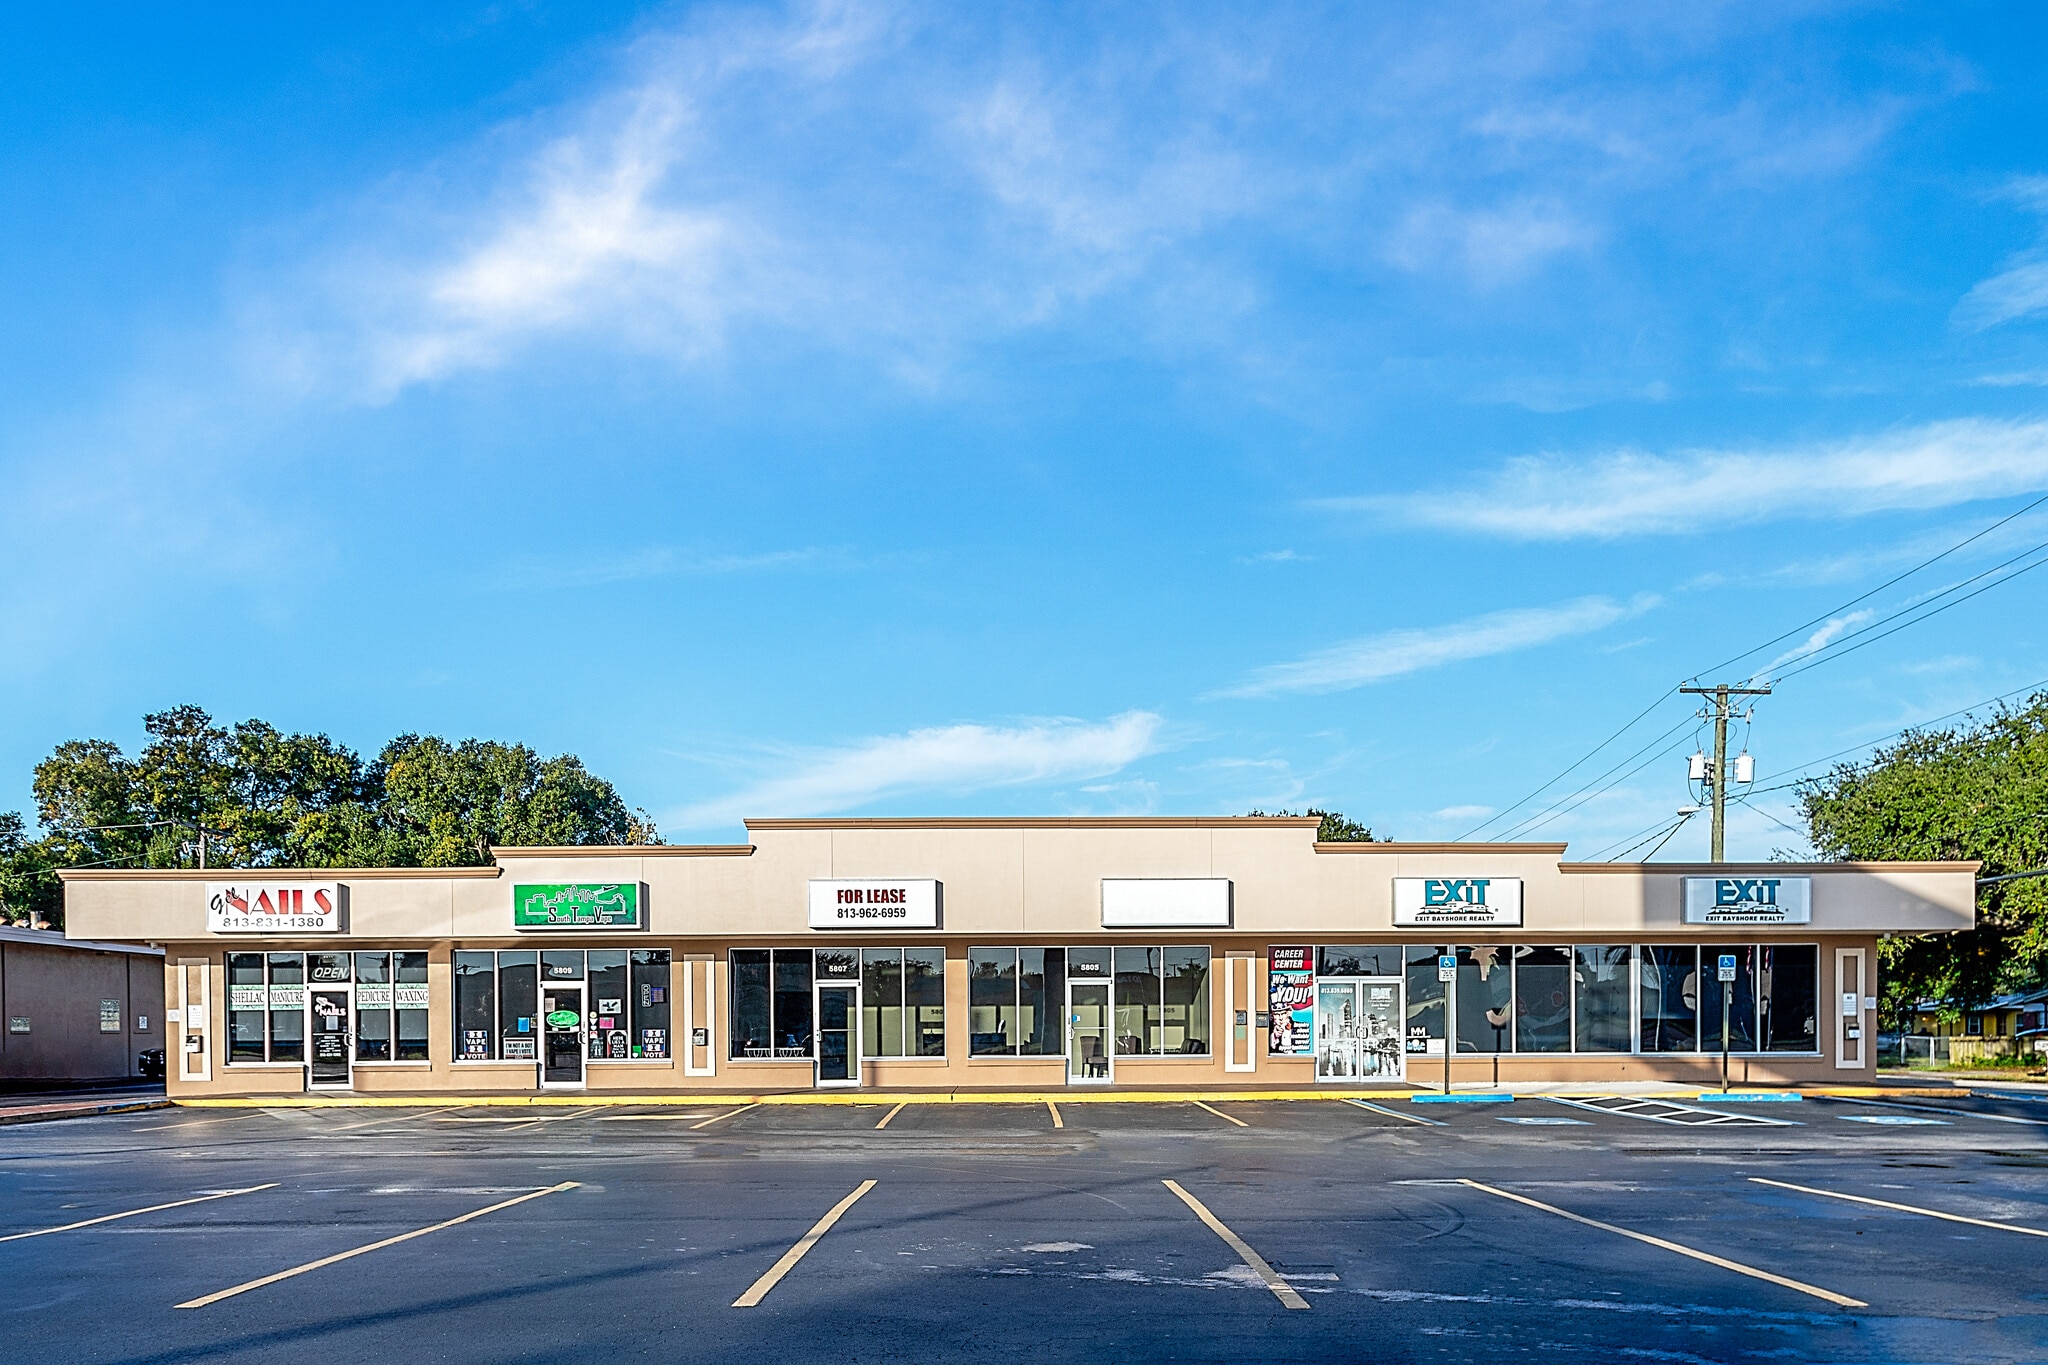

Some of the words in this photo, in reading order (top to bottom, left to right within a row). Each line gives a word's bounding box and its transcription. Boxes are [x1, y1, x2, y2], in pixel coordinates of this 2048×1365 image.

[225, 889, 332, 915] NAILS
[837, 889, 863, 904] FOR
[867, 889, 906, 904] LEASE
[548, 906, 571, 923] South
[571, 906, 594, 924] Tampa
[594, 906, 613, 924] Vape
[837, 908, 906, 918] 813-962-6959
[223, 918, 323, 927] 813-831-1380
[1274, 950, 1304, 958] CAREER
[1274, 960, 1304, 968] CENTER
[314, 967, 348, 978] OPEN
[1272, 975, 1285, 984] We
[1287, 975, 1309, 984] Want
[231, 992, 264, 1003] SHELLAC
[270, 992, 304, 1003] MANICURE
[357, 991, 390, 1002] PEDICURE
[396, 990, 428, 1002] WAXING
